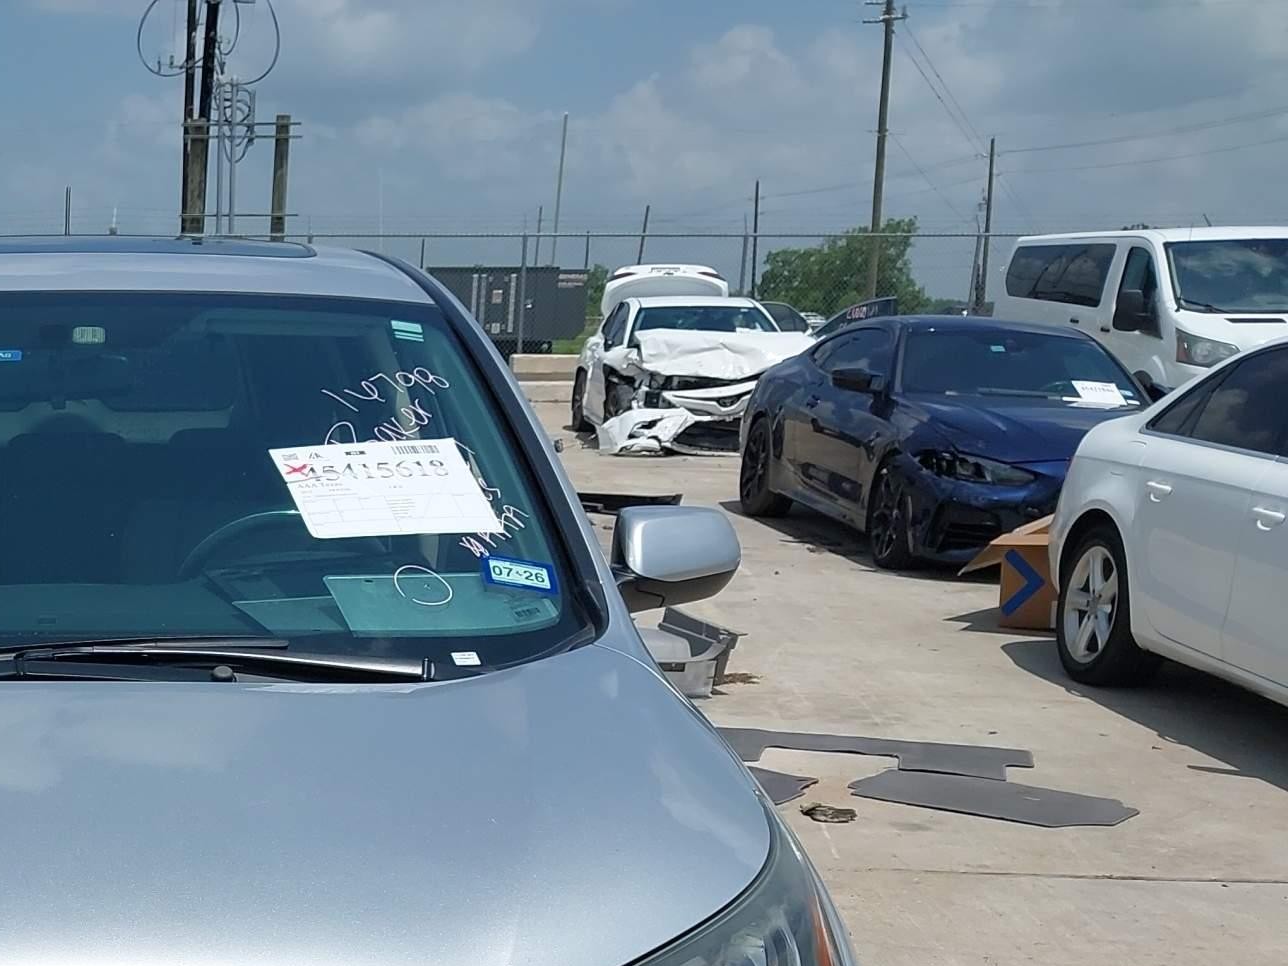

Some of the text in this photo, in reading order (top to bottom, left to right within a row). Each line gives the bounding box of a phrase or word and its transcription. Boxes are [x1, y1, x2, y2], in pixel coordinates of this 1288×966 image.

[305, 459, 449, 482] 45415618
[492, 565, 545, 583] 07 26
